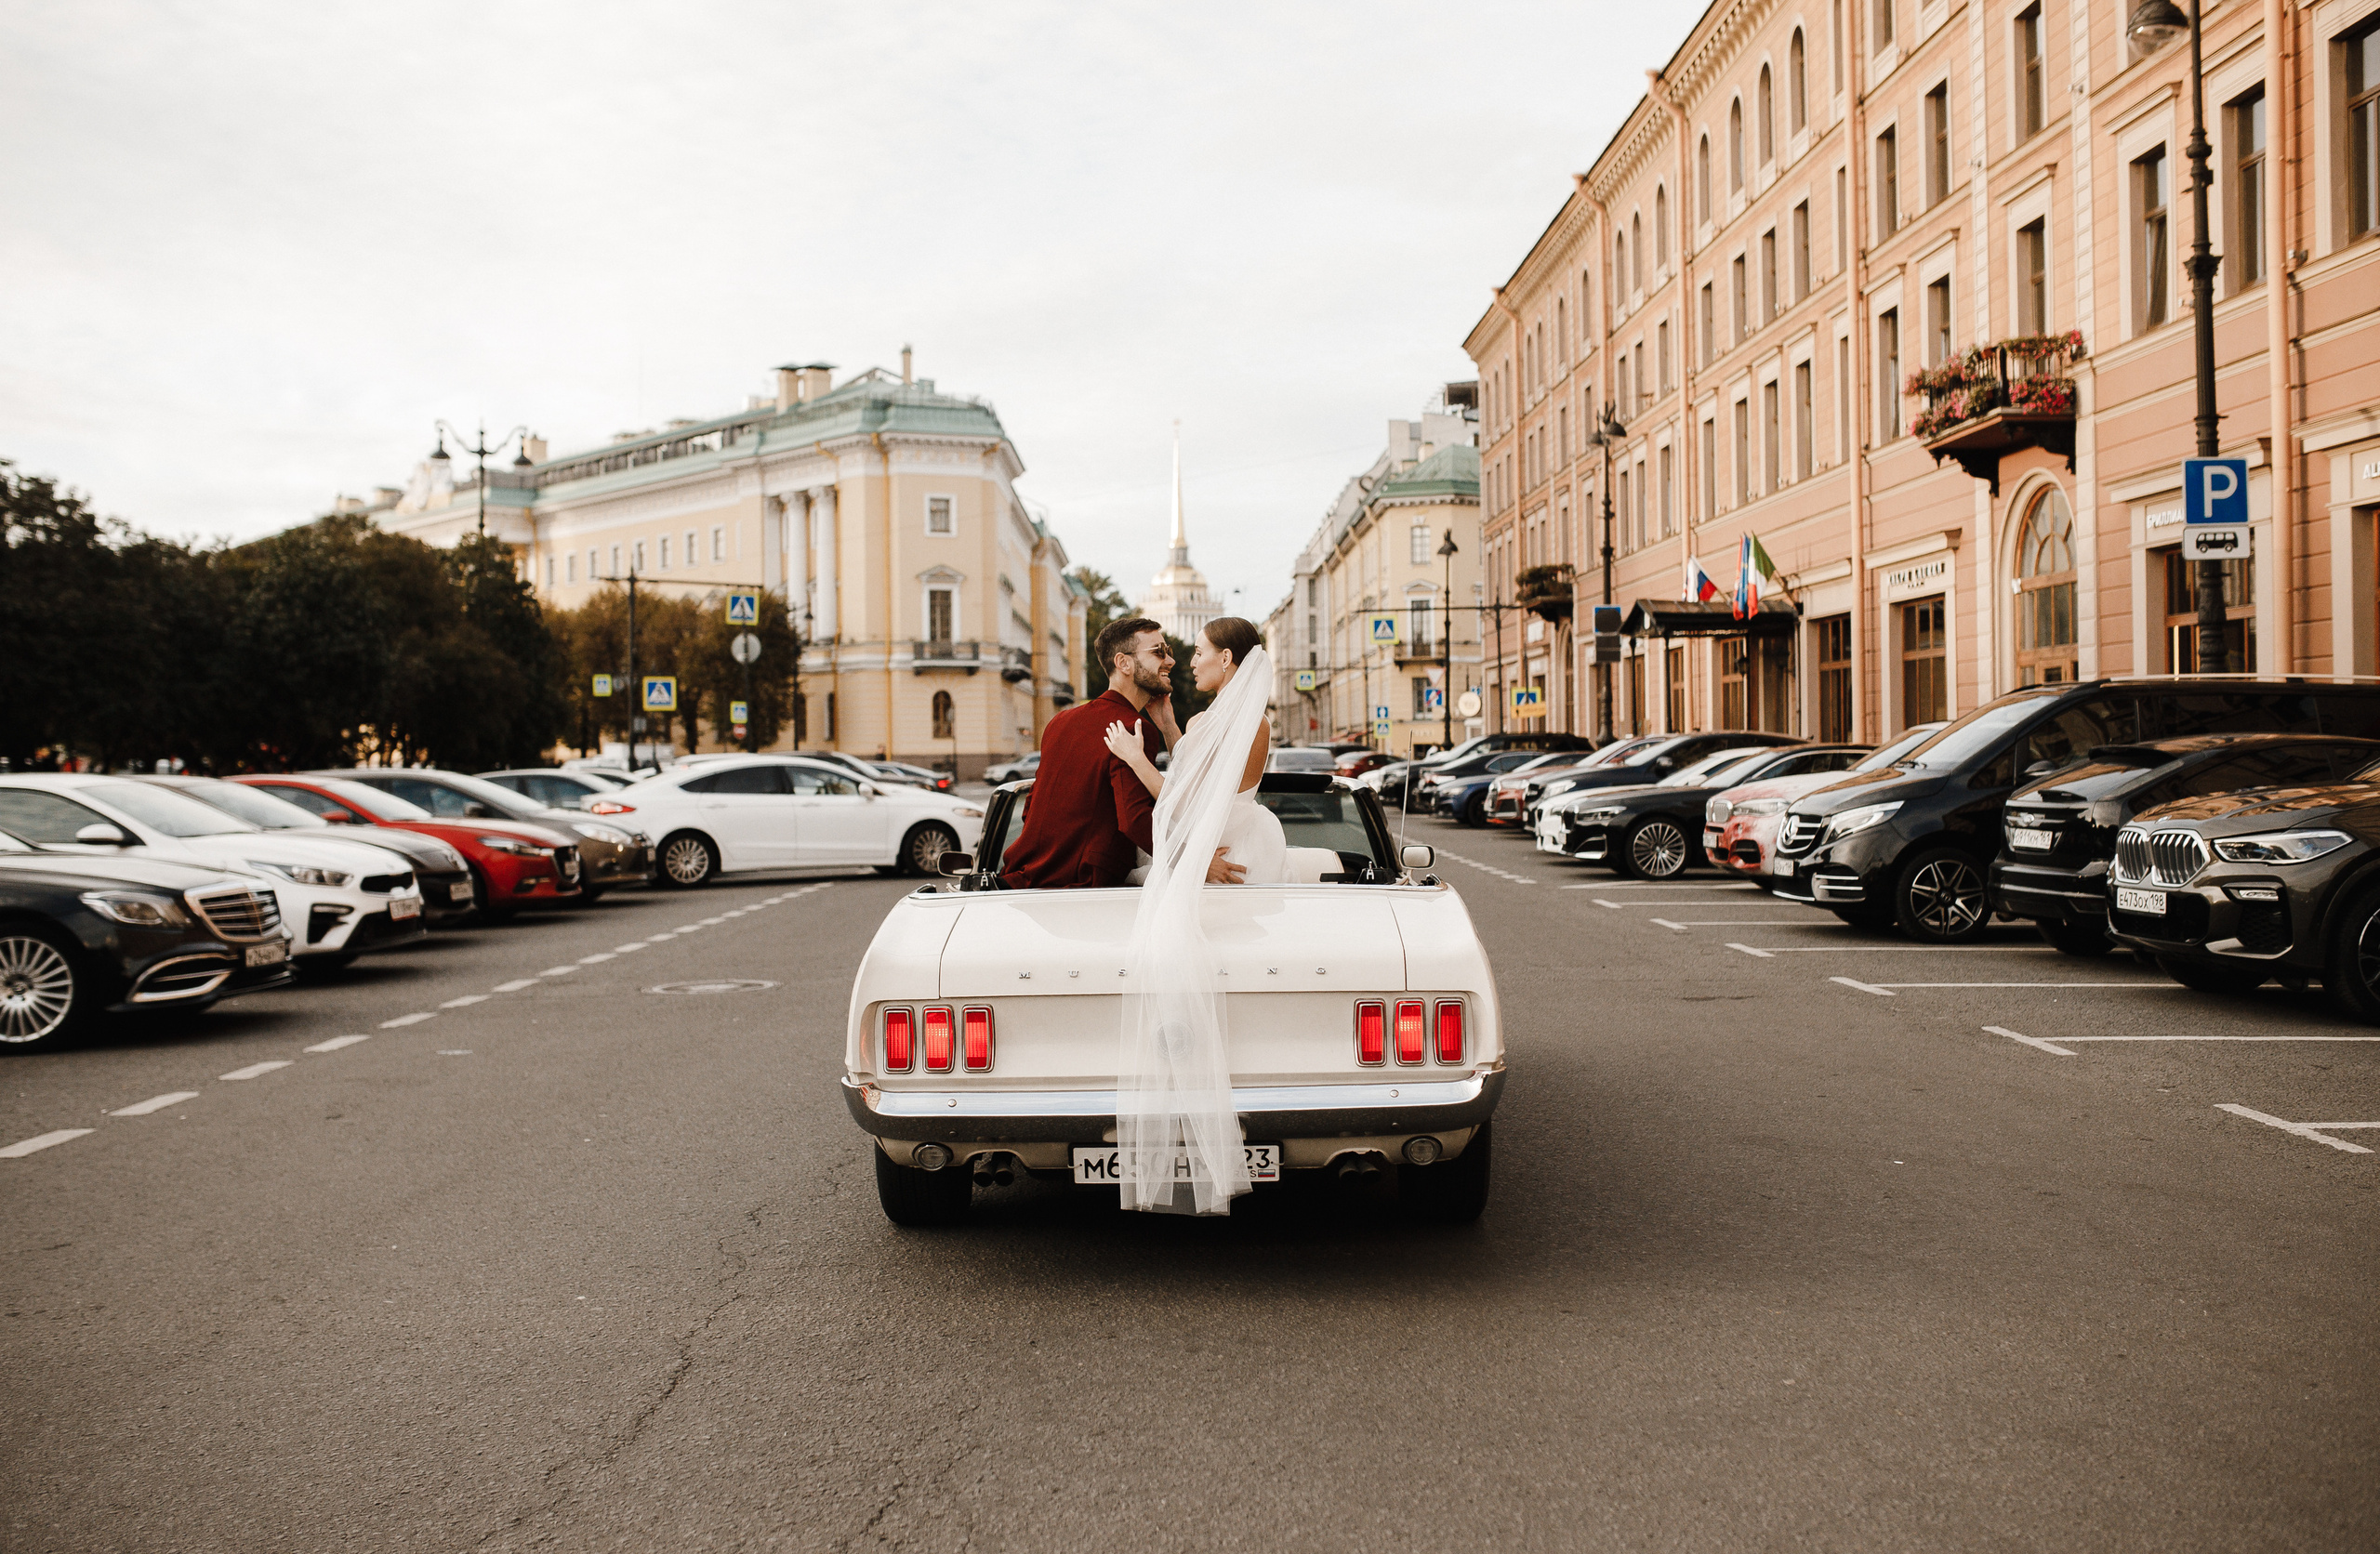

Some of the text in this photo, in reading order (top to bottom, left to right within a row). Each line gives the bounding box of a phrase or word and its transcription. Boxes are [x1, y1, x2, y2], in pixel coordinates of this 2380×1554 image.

[2203, 465, 2238, 519] P
[2150, 894, 2164, 907] 198
[1018, 967, 1327, 980] MUSANG
